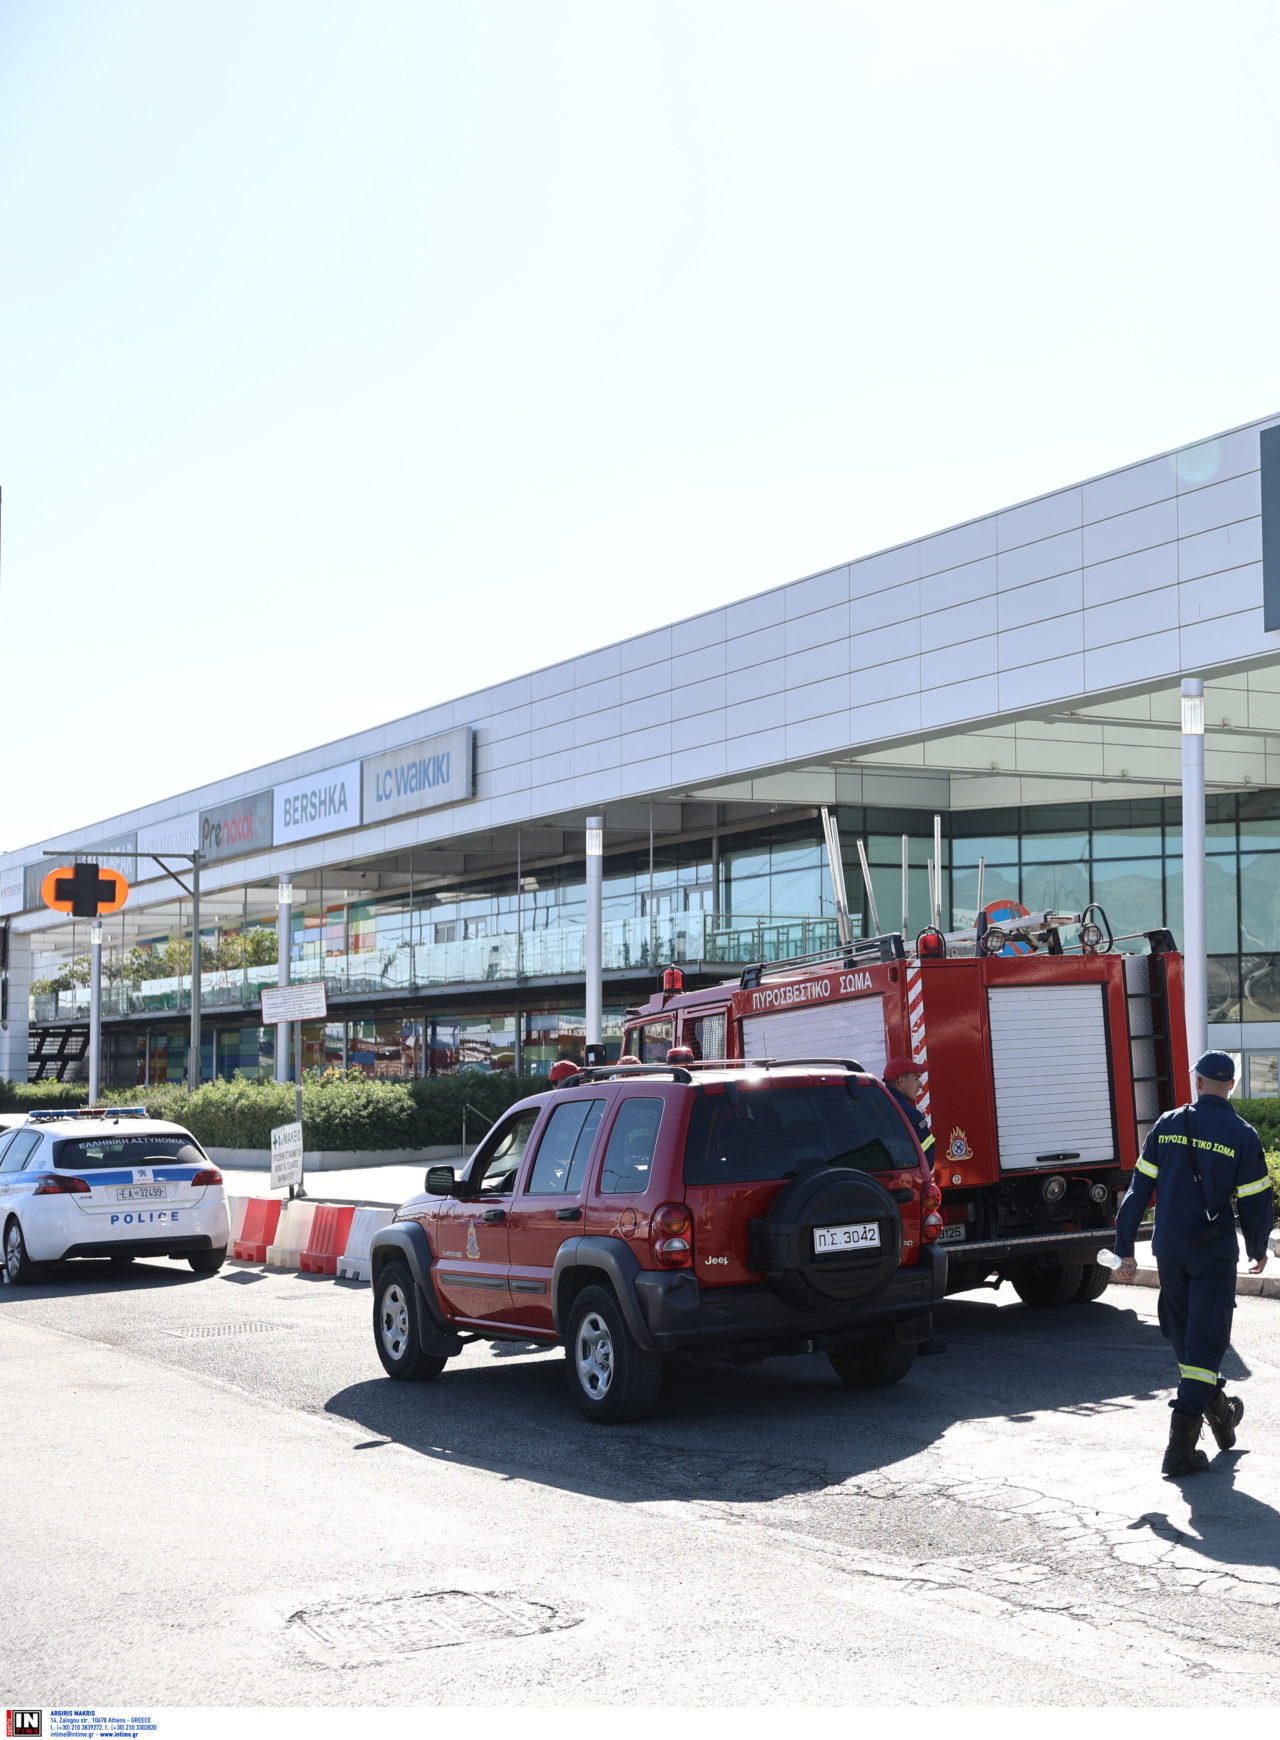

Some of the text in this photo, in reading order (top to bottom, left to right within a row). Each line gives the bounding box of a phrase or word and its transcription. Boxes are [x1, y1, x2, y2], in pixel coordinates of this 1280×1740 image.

[375, 769, 393, 803] LC
[283, 782, 348, 828] BERSHKA
[752, 971, 873, 1010] ΠΥΡΟΣΒΕΣΤΙΚΟ ΣΩΜΑ
[79, 1136, 185, 1150] ΕΛΛΗΝΙΚΗ ΑΣΤΥΝΟΜΙΑ
[1158, 1134, 1235, 1158] ΠΥΡΟΣΒΣΤΙΚΟ ΣΩΜΑ
[110, 1211, 179, 1225] POLICE
[843, 1228, 876, 1244] 3042
